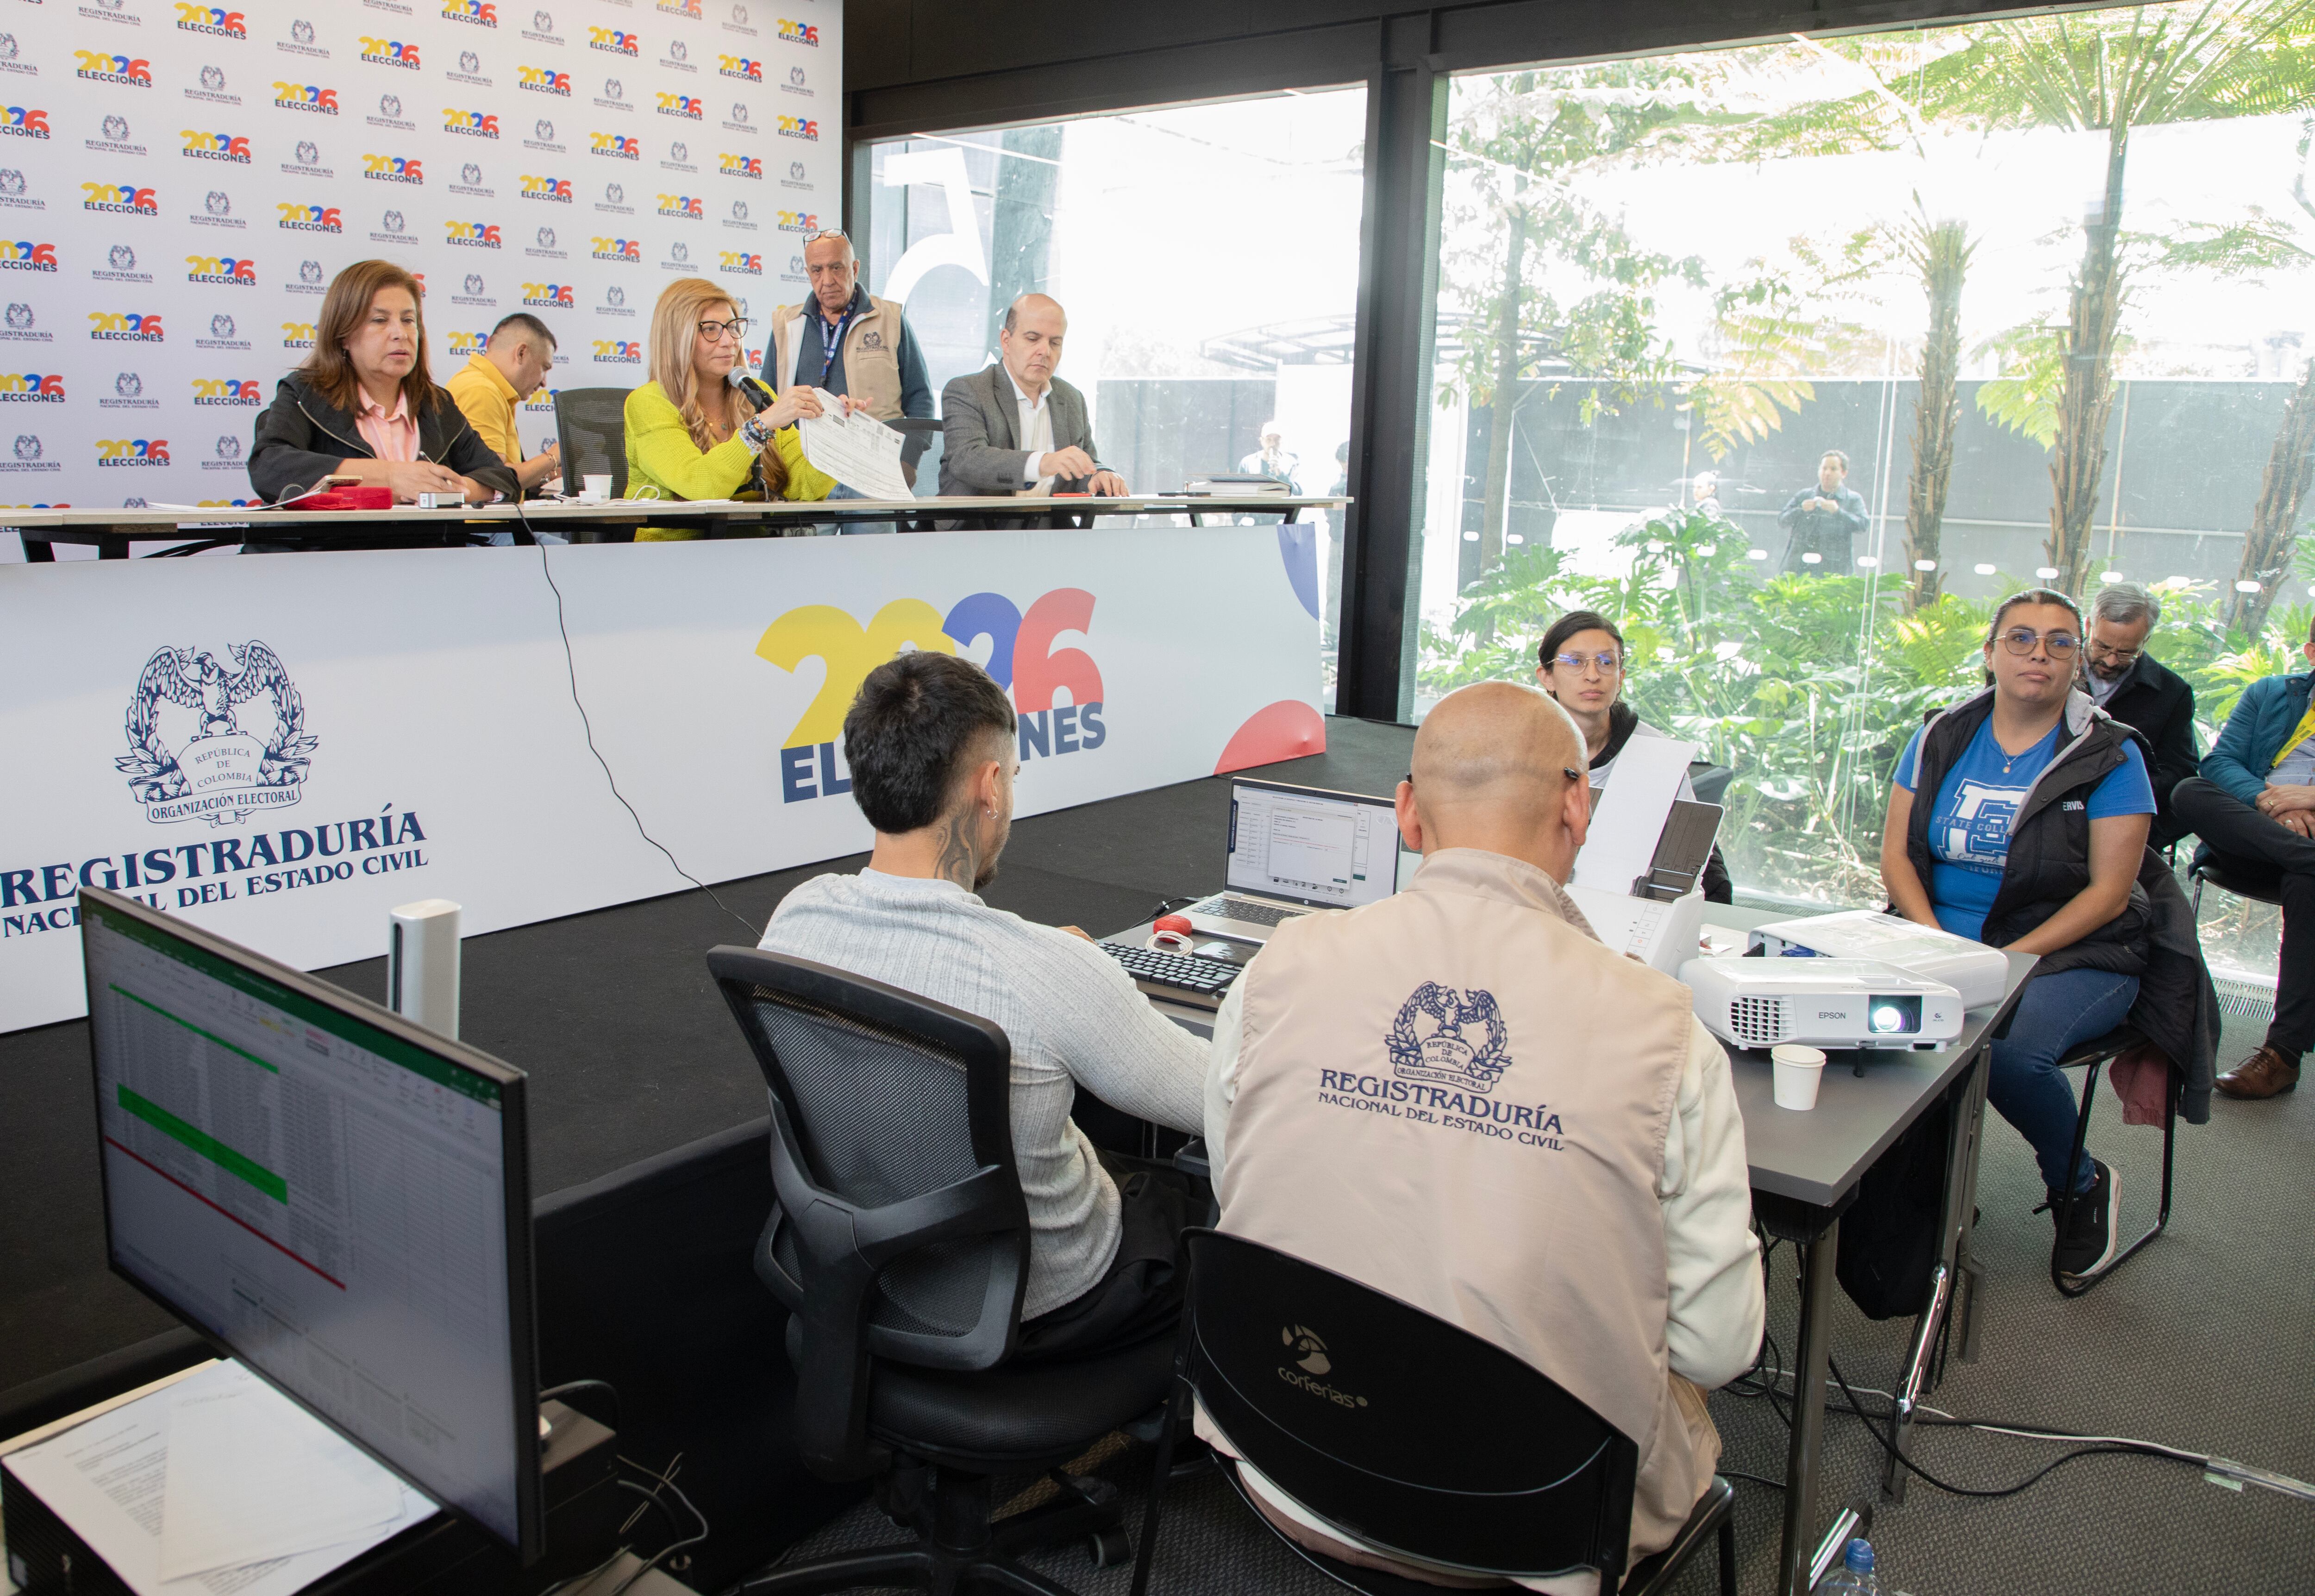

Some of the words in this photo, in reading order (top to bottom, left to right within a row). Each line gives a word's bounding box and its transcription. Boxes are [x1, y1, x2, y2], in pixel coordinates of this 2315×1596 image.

[78, 7, 140, 22] REGISTRADURÍA
[174, 2, 245, 32] 2026
[439, 0, 496, 22] 2026
[442, 11, 496, 28] ELECCIONES
[177, 21, 245, 39] ELECCIONES
[588, 26, 638, 51] 2026
[777, 19, 819, 42] 2026
[779, 32, 819, 47] ELECCIONES
[276, 42, 329, 55] REGISTRADURÍA
[358, 36, 419, 63] 2026
[590, 41, 638, 56] ELECCIONES
[0, 57, 37, 72] RADURÍA
[73, 50, 151, 80] 2026
[361, 53, 419, 69] ELECCIONES
[718, 54, 762, 77] 2026
[77, 69, 151, 87] ELECCIONES
[517, 66, 570, 90] 2026
[720, 68, 762, 82] ELECCIONES
[184, 89, 241, 101] REGISTRADURÍA
[272, 81, 338, 108] 2026
[519, 81, 570, 96] ELECCIONES
[275, 99, 338, 115] ELECCIONES
[655, 92, 702, 114] 2026
[442, 108, 499, 133] 2026
[657, 106, 702, 120] ELECCIONES
[0, 122, 50, 139] CIONES
[444, 125, 499, 139] ELECCIONES
[777, 115, 818, 136] 2026
[179, 130, 250, 156] 2026
[589, 131, 638, 154] 2026
[779, 129, 818, 141] ELECCIONES
[85, 140, 146, 152] REGISTRADURÍA
[591, 147, 638, 160] ELECCIONES
[183, 148, 250, 163] ELECCIONES
[718, 153, 762, 174] 2026
[281, 164, 333, 174] REGISTRADURÍA
[362, 154, 423, 178] 2026
[720, 167, 762, 179] ELECCIONES
[365, 171, 423, 184] ELECCIONES
[519, 175, 572, 197] 2026
[0, 195, 45, 206] STRADURÍA
[80, 182, 157, 208] 2026
[521, 190, 572, 202] ELECCIONES
[656, 193, 702, 213] 2026
[84, 201, 157, 215] ELECCIONES
[276, 203, 342, 226] 2026
[658, 208, 702, 219] ELECCIONES
[190, 215, 246, 225] REGISTRADURÍA
[280, 220, 342, 233] ELECCIONES
[776, 210, 817, 229] 2026
[444, 220, 501, 242] 2026
[0, 238, 56, 264] 026
[447, 237, 501, 248] ELECCIONES
[590, 236, 639, 257] 2026
[0, 258, 56, 271] CCIONES
[593, 251, 639, 262] ELECCIONES
[718, 250, 762, 269] 2026
[92, 270, 152, 279] REGISTRADURÍA
[185, 255, 255, 278] 2026
[720, 265, 761, 274] ELECCIONES
[189, 274, 256, 285] ELECCIONES
[521, 282, 573, 302] 2026
[523, 298, 573, 307] ELECCIONES
[87, 312, 163, 334] 2026
[281, 323, 318, 340] 20
[91, 331, 163, 341] ELECCIONES
[447, 332, 489, 348] 202
[592, 339, 640, 357] 2026
[0, 373, 64, 394] 026
[191, 378, 260, 399] 2026
[0, 393, 64, 401] ECCIONES
[194, 397, 260, 405] ELECCIONES
[94, 439, 169, 458] 2026
[195, 747, 250, 764] REPÚBLICA
[781, 701, 1106, 803] ELNES
[197, 772, 252, 787] COLOMBIA
[152, 793, 234, 819] ORGANIZACIÓN
[238, 790, 297, 805] ELECTORAL
[2063, 801, 2084, 811] ERVIS
[1936, 816, 1972, 829] STATE
[1977, 823, 2005, 833] COLL
[0, 803, 427, 908] REGISTRADURÍA
[3, 893, 167, 938] NACIL
[177, 881, 237, 908] DEL
[246, 861, 353, 896] ESTADO
[363, 849, 429, 875] CIVIL
[1427, 1041, 1468, 1056] REPÚBLICA
[1426, 1056, 1463, 1070] COLOMBIA
[1397, 1068, 1446, 1080] ORGANIZACIÓN
[1449, 1074, 1485, 1090] ELECTORAL
[1320, 1069, 1564, 1135] REGISTRADURÍA
[1318, 1092, 1402, 1116] NACIONAL
[1405, 1107, 1439, 1123] DEL
[1442, 1114, 1513, 1139] ESTADO
[1518, 1132, 1564, 1151] CIVIL
[1278, 1367, 1355, 1408] corferias
